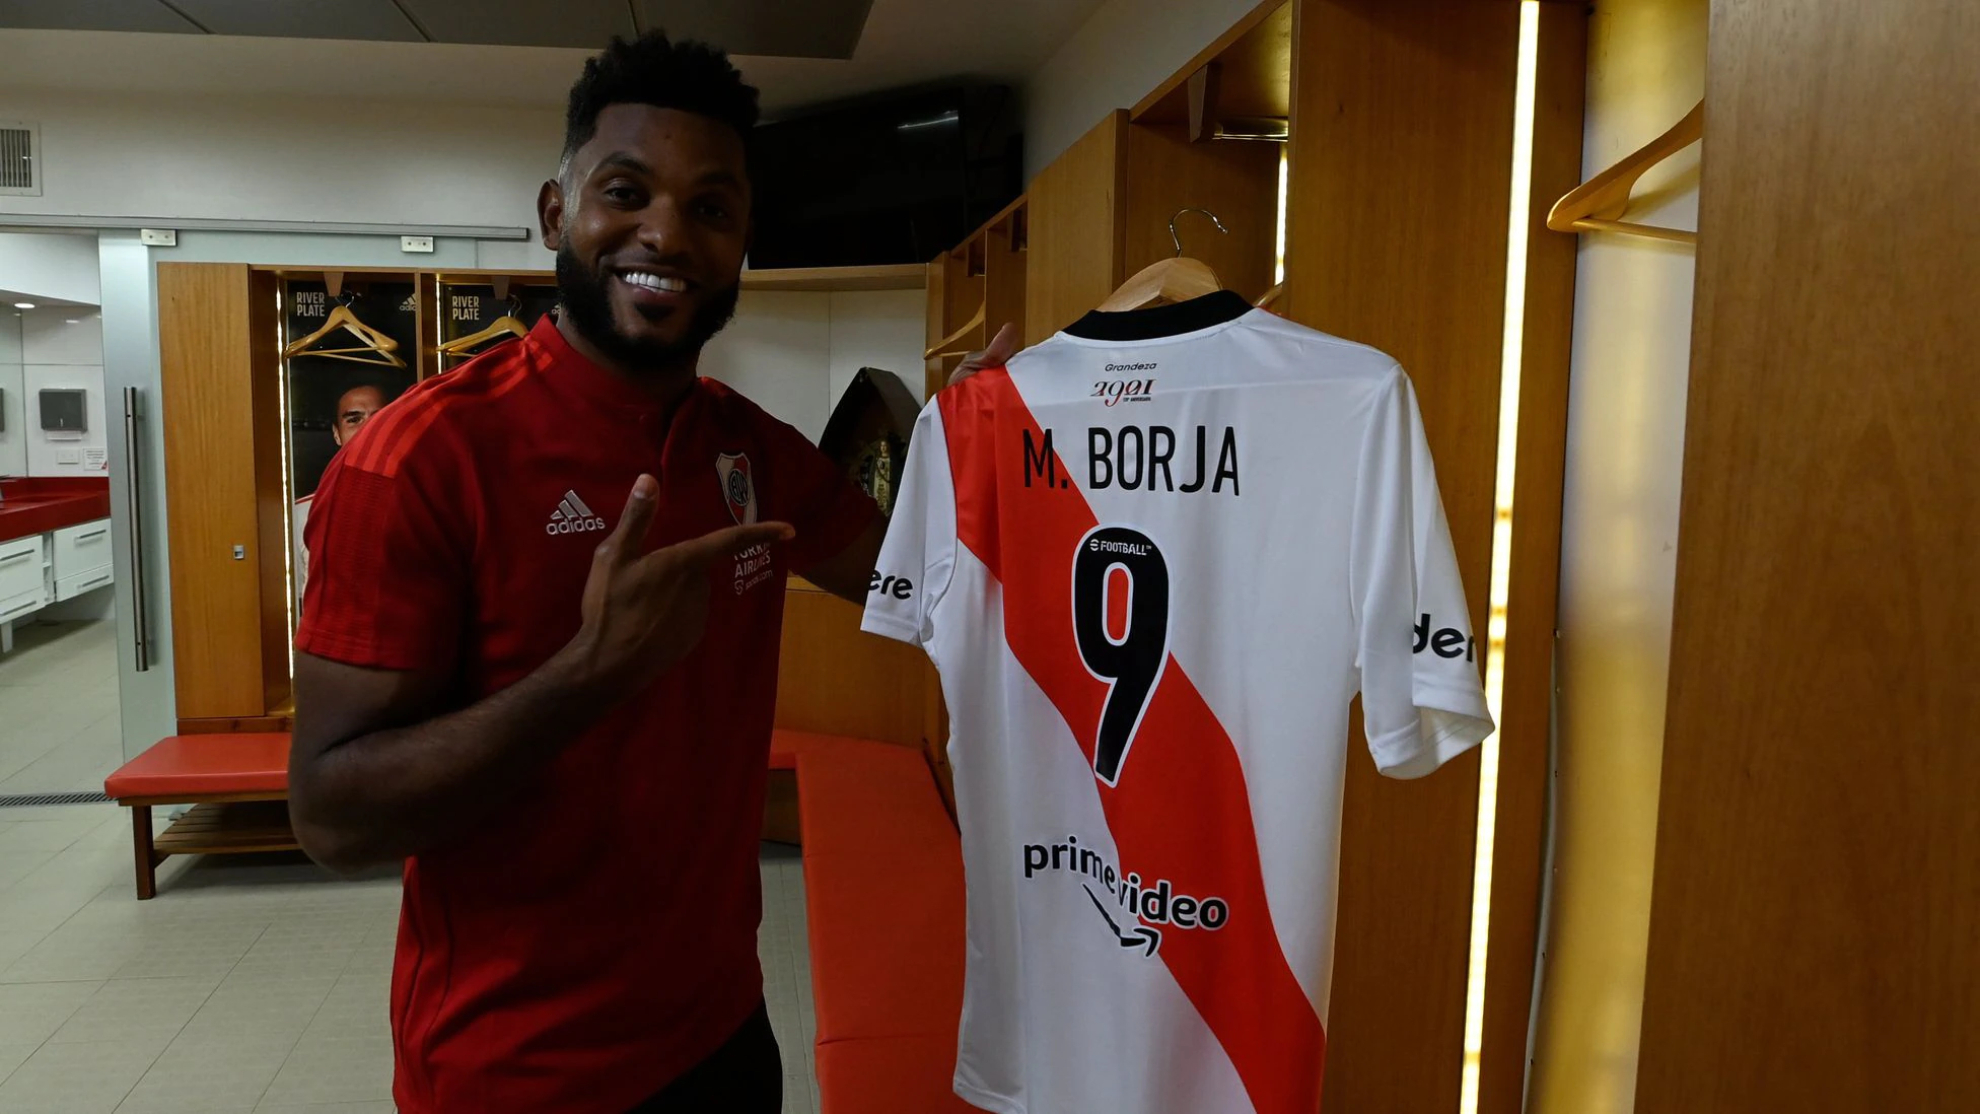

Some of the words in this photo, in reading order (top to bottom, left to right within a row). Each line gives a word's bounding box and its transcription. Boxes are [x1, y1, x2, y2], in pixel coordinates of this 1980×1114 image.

[296, 291, 326, 304] RIVER
[452, 295, 480, 308] RIVER
[296, 304, 326, 317] PLATE
[452, 308, 480, 320] PLATE
[1104, 362, 1158, 372] Grandeza
[1022, 428, 1068, 489] M.
[1088, 425, 1240, 496] BORJA
[546, 515, 606, 536] adidas
[1072, 524, 1170, 788] 9
[1023, 836, 1116, 894] prime
[1119, 874, 1227, 928] video
